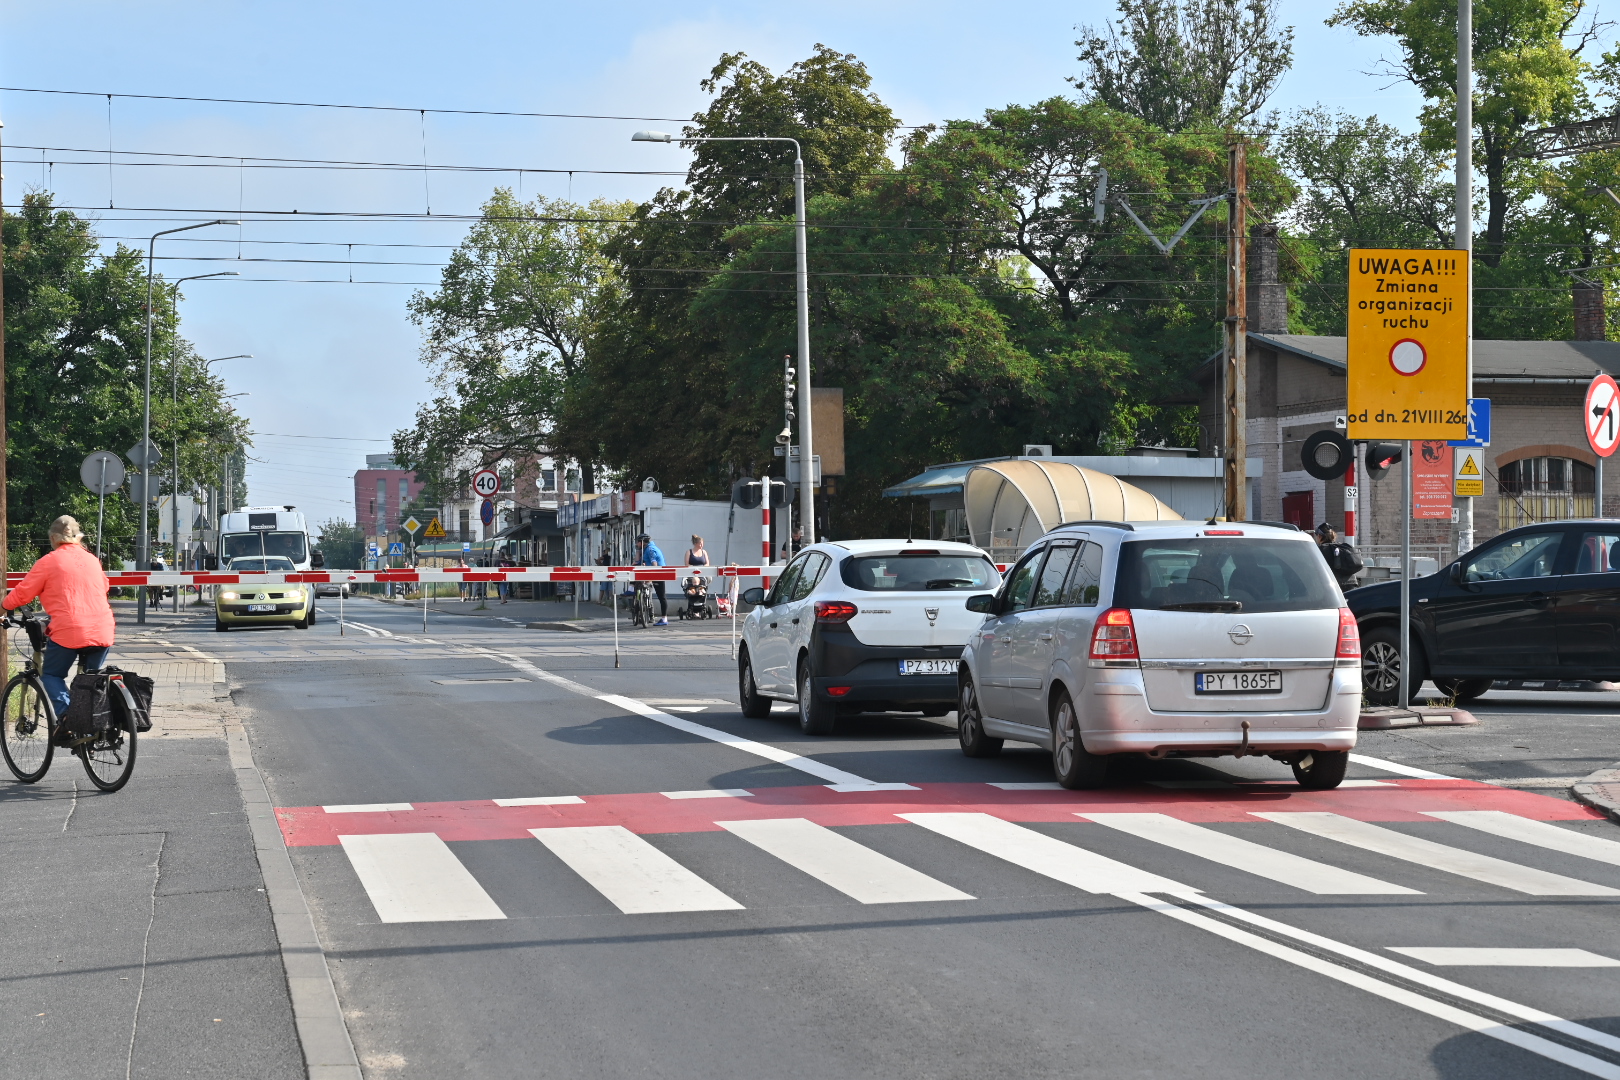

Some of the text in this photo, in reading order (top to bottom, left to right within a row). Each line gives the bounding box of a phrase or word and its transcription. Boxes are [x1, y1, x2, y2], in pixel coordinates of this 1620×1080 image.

[1359, 257, 1456, 276] UWAGA!!!
[1375, 278, 1438, 293] Zmiana
[1358, 297, 1453, 315] organizacji
[1383, 314, 1429, 329] ruchu
[1347, 408, 1368, 423] od
[1374, 408, 1398, 423] dn.
[476, 476, 496, 490] 40
[1347, 487, 1357, 497] S2
[906, 660, 923, 672] PZ
[1206, 673, 1277, 690] PY 1865F
